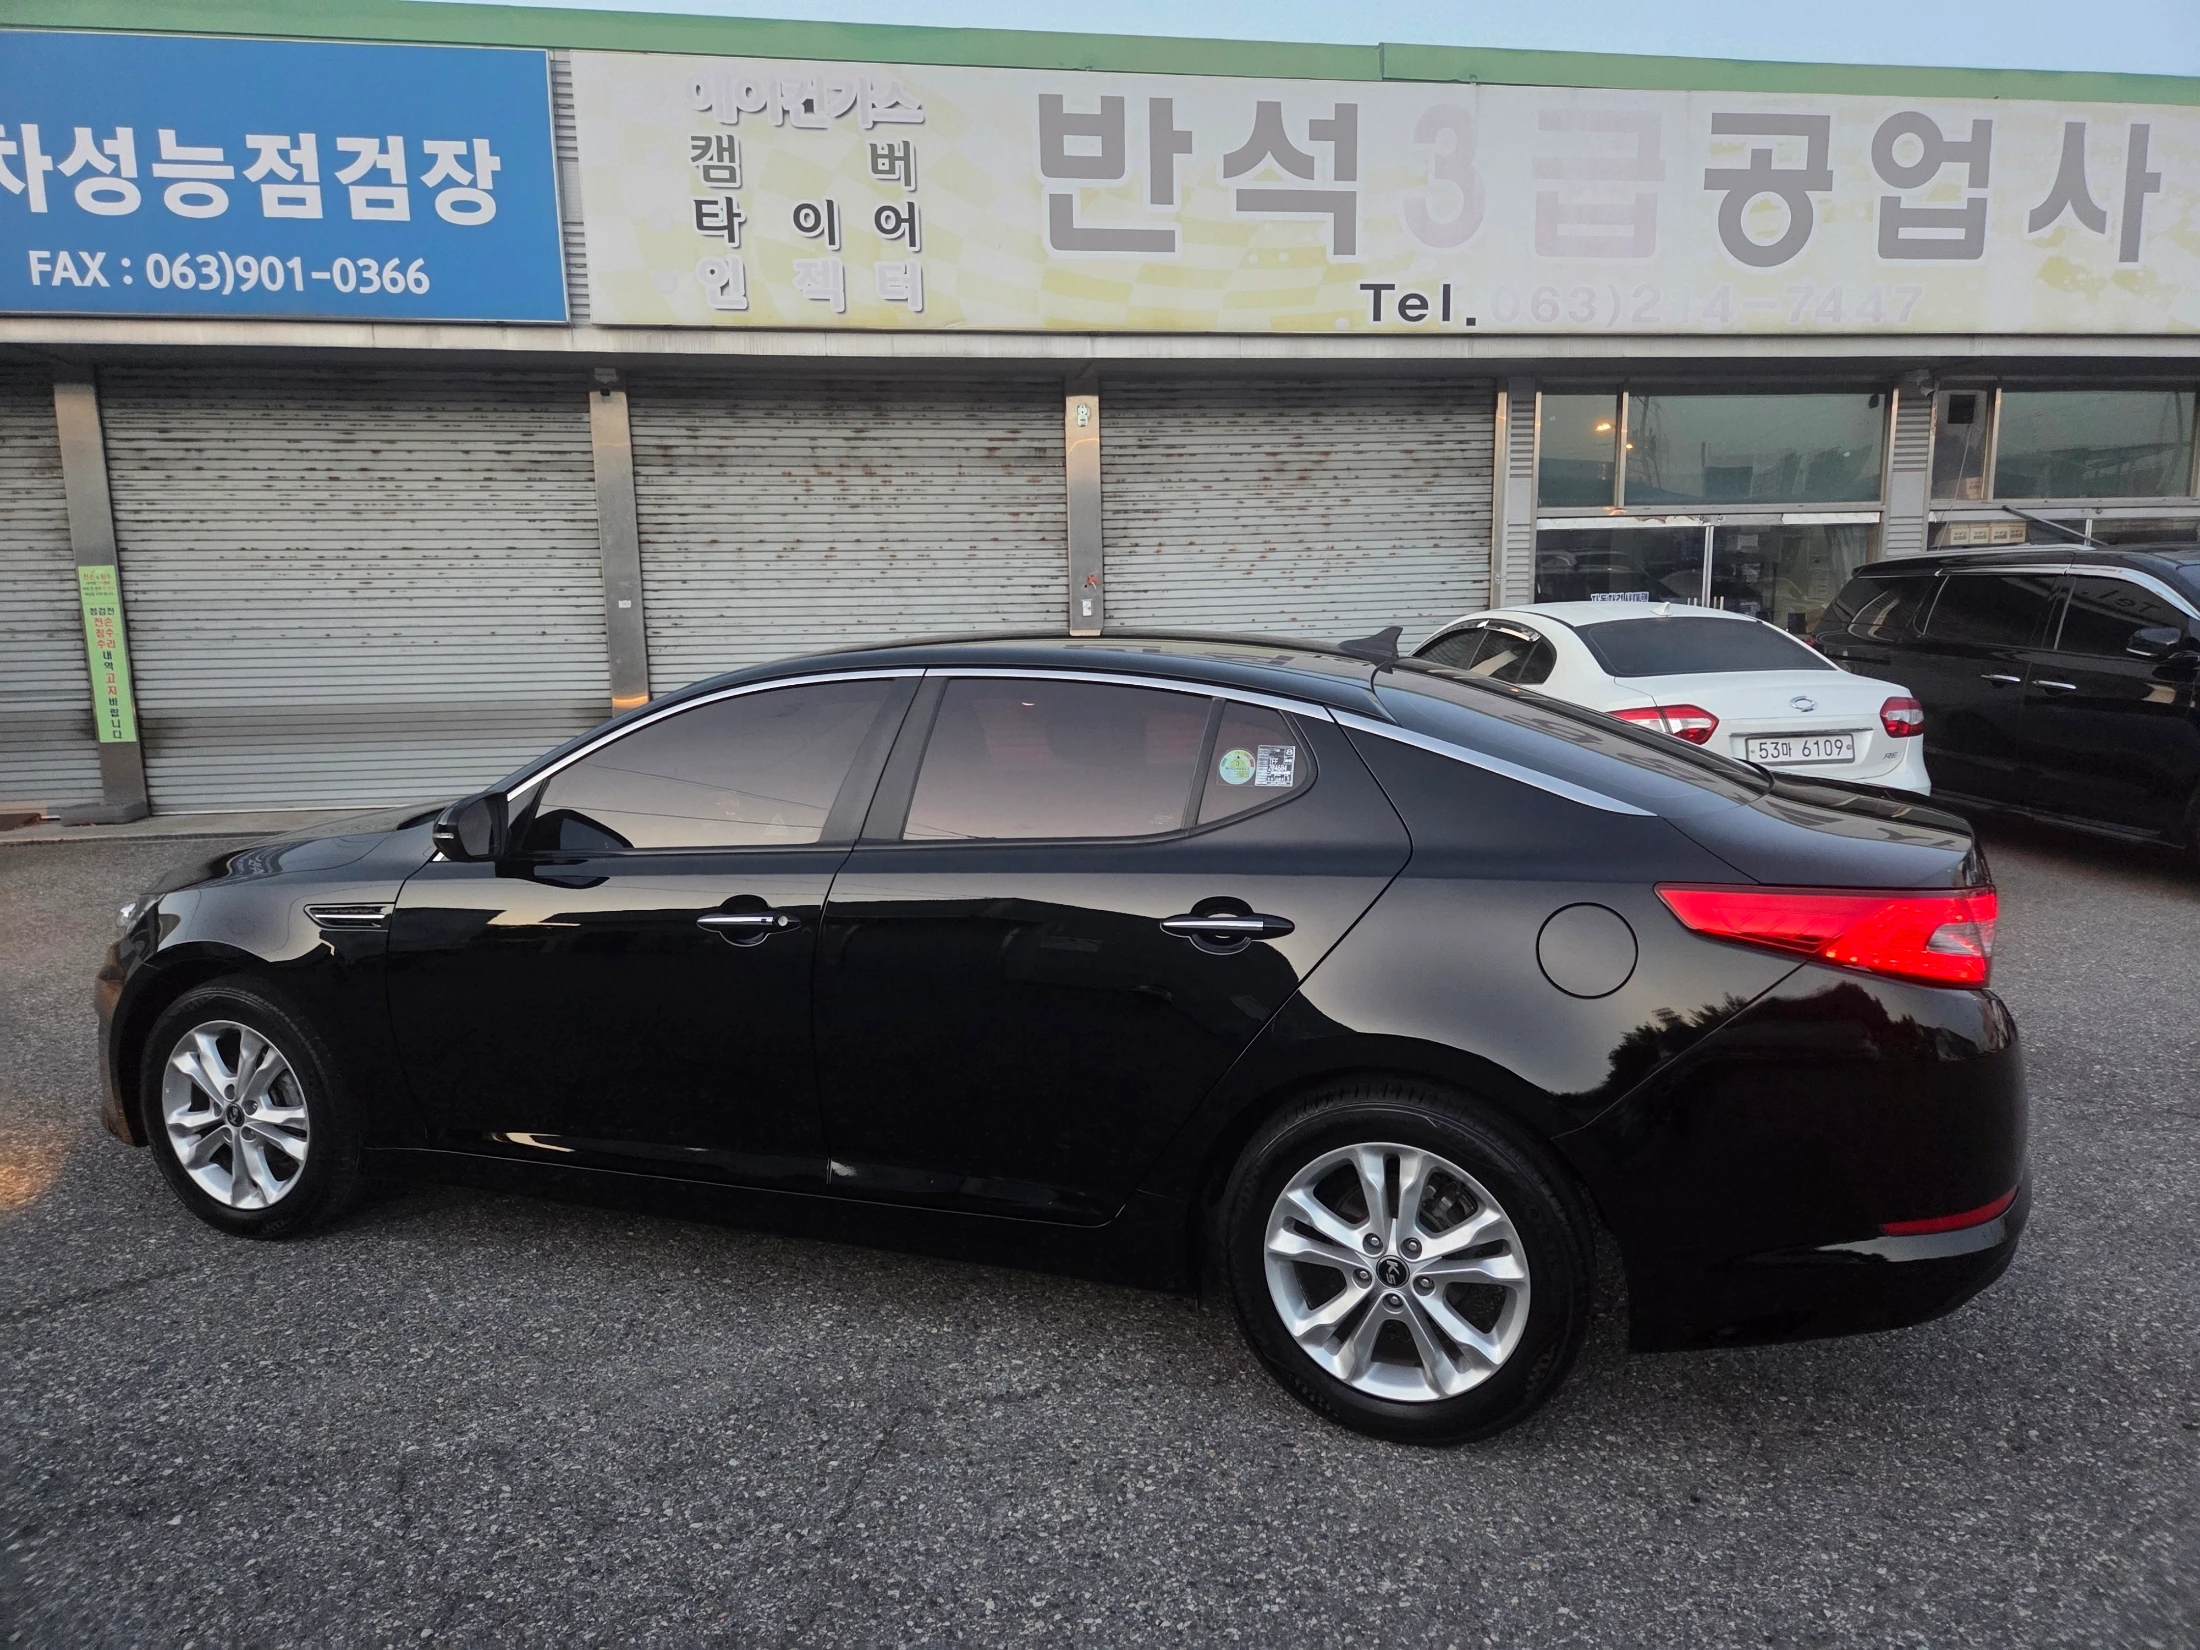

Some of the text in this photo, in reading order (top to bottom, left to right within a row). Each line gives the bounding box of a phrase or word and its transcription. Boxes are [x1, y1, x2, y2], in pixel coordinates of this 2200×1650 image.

[145, 252, 430, 295] 063)901-0366
[1359, 283, 1477, 327] Tel.
[1758, 739, 1844, 760] 53마 6109
